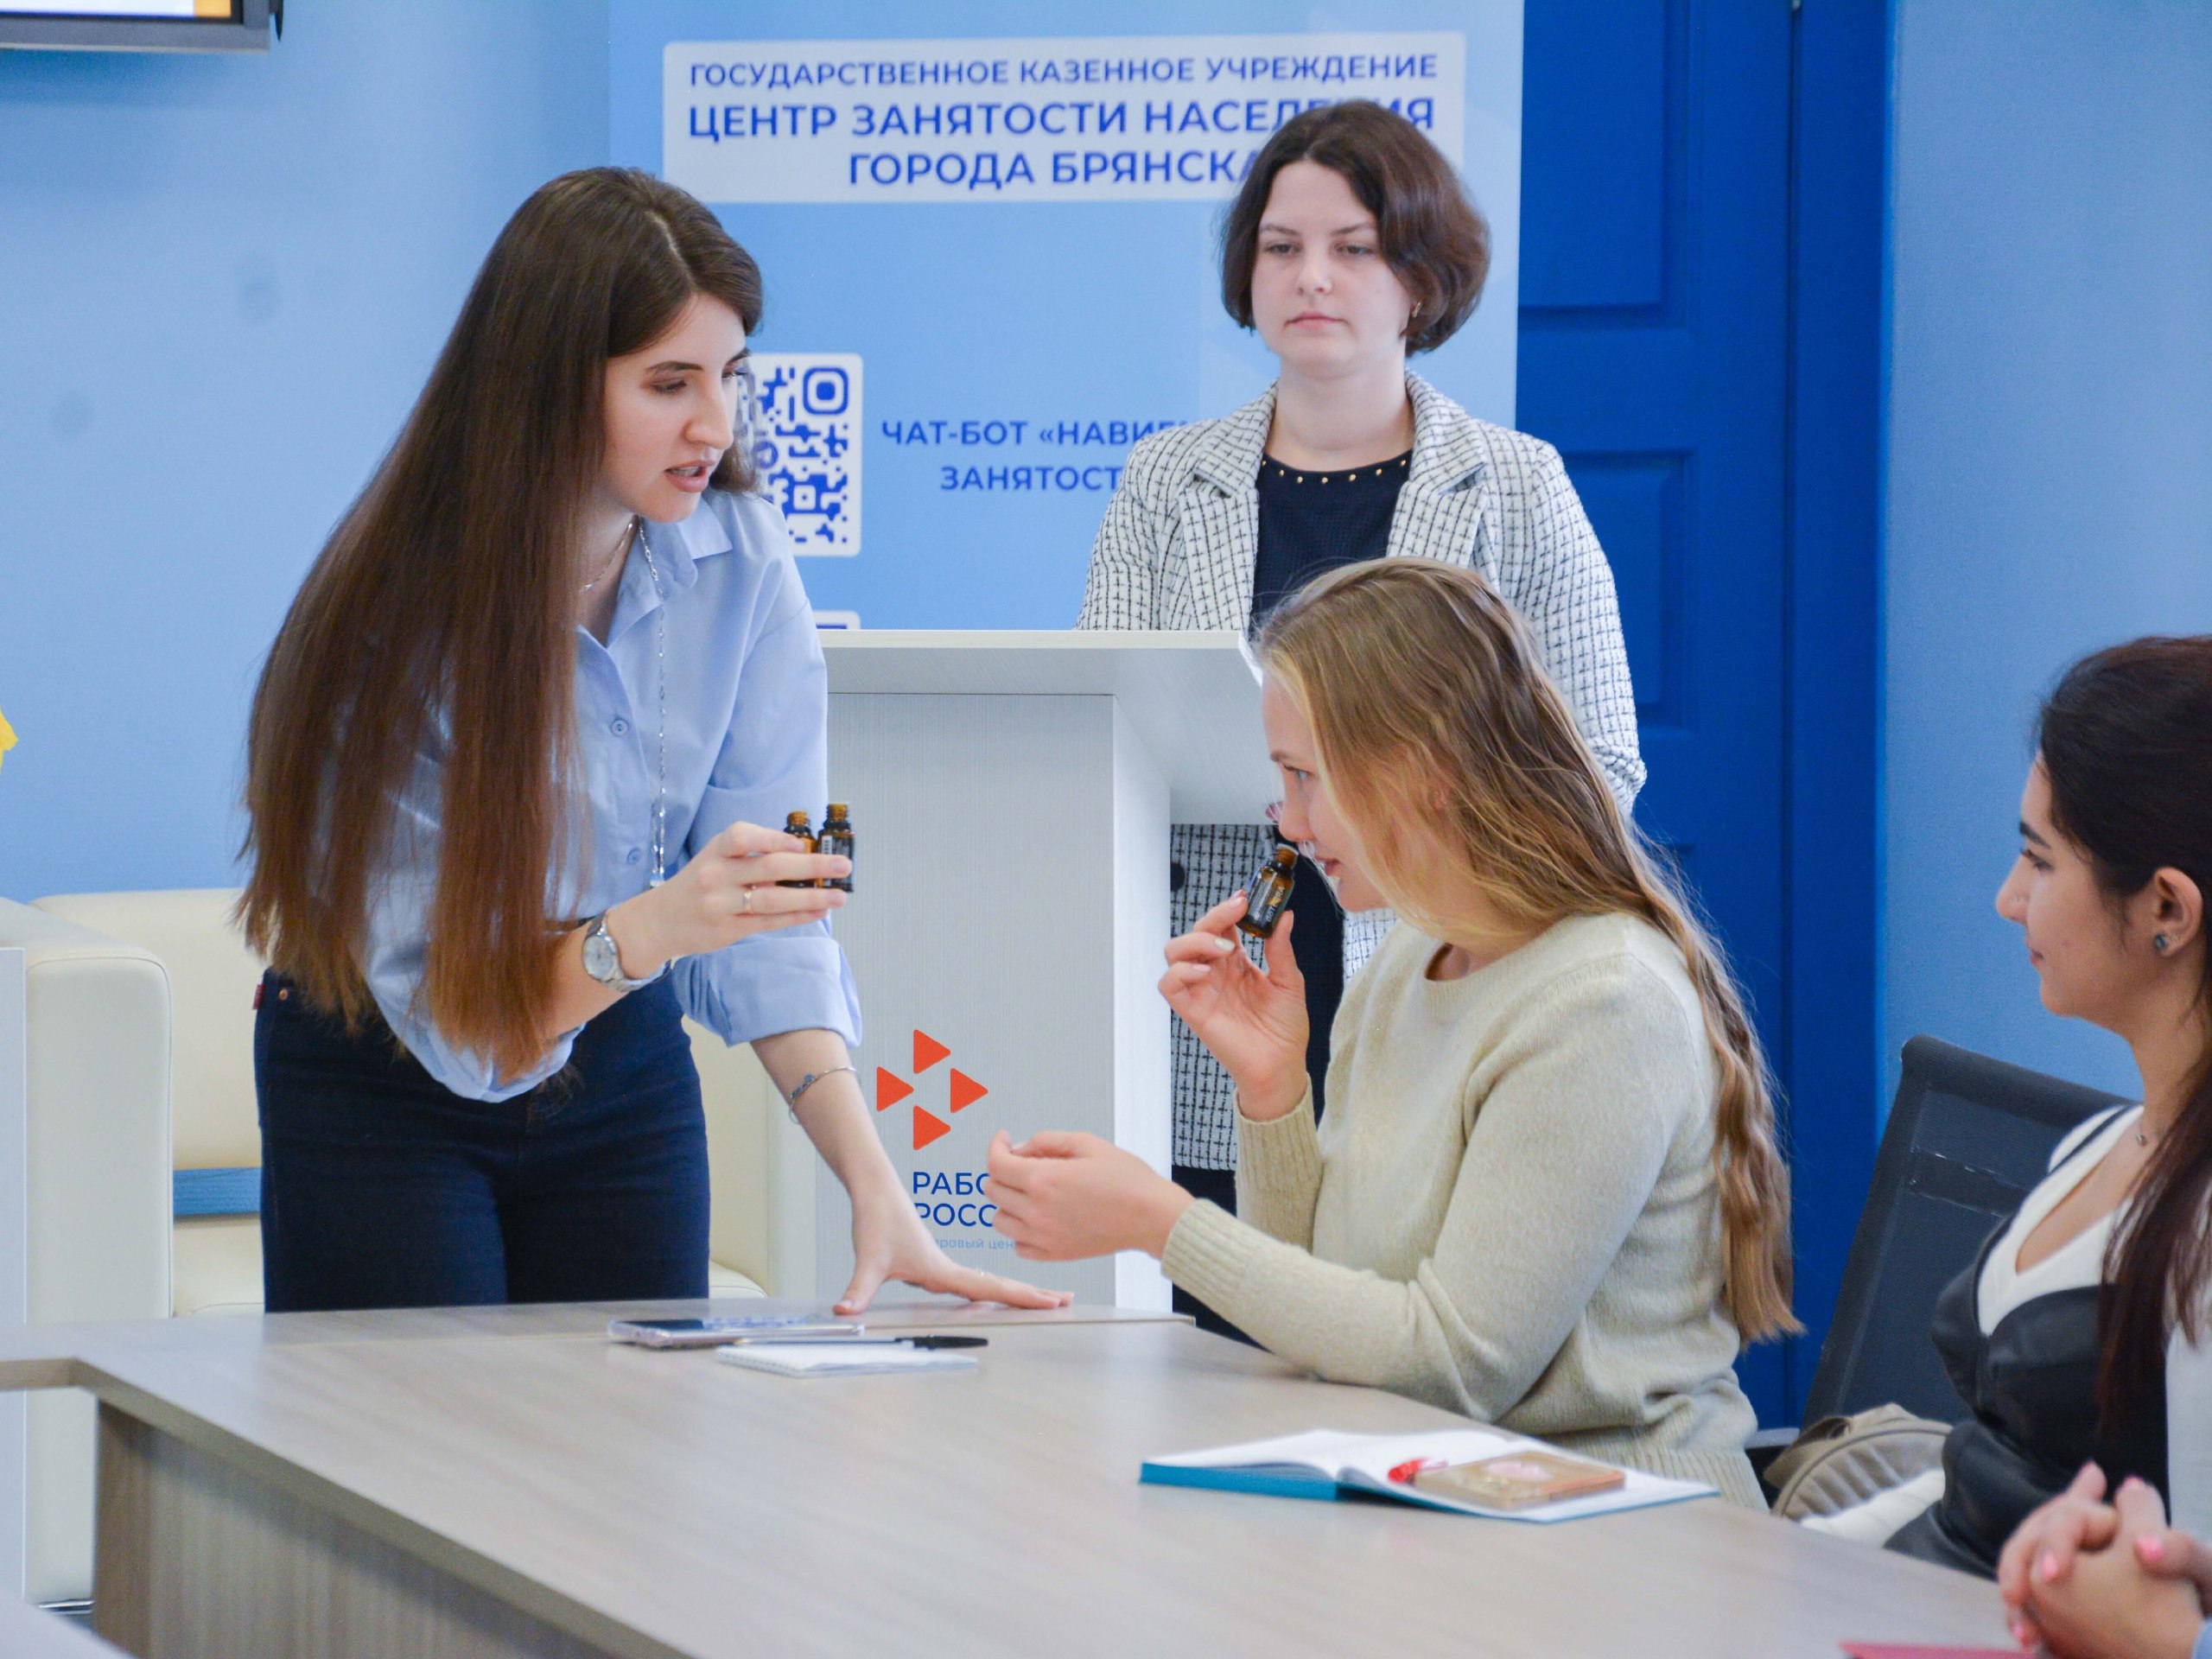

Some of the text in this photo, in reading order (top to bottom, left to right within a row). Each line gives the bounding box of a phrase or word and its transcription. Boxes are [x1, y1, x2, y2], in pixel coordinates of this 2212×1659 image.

[690, 54, 1437, 89] ГОСУДАРСТВЕННОЕ КАЗЕННОЕ УЧРЕЖДЕНИЕ
[690, 97, 1435, 143] ЦЕНТР ЗАНЯТОСТИ НАСЕЛЯ
[849, 152, 1035, 190] ГОРОДА
[881, 420, 1028, 446] ЧАТ-БОТ
